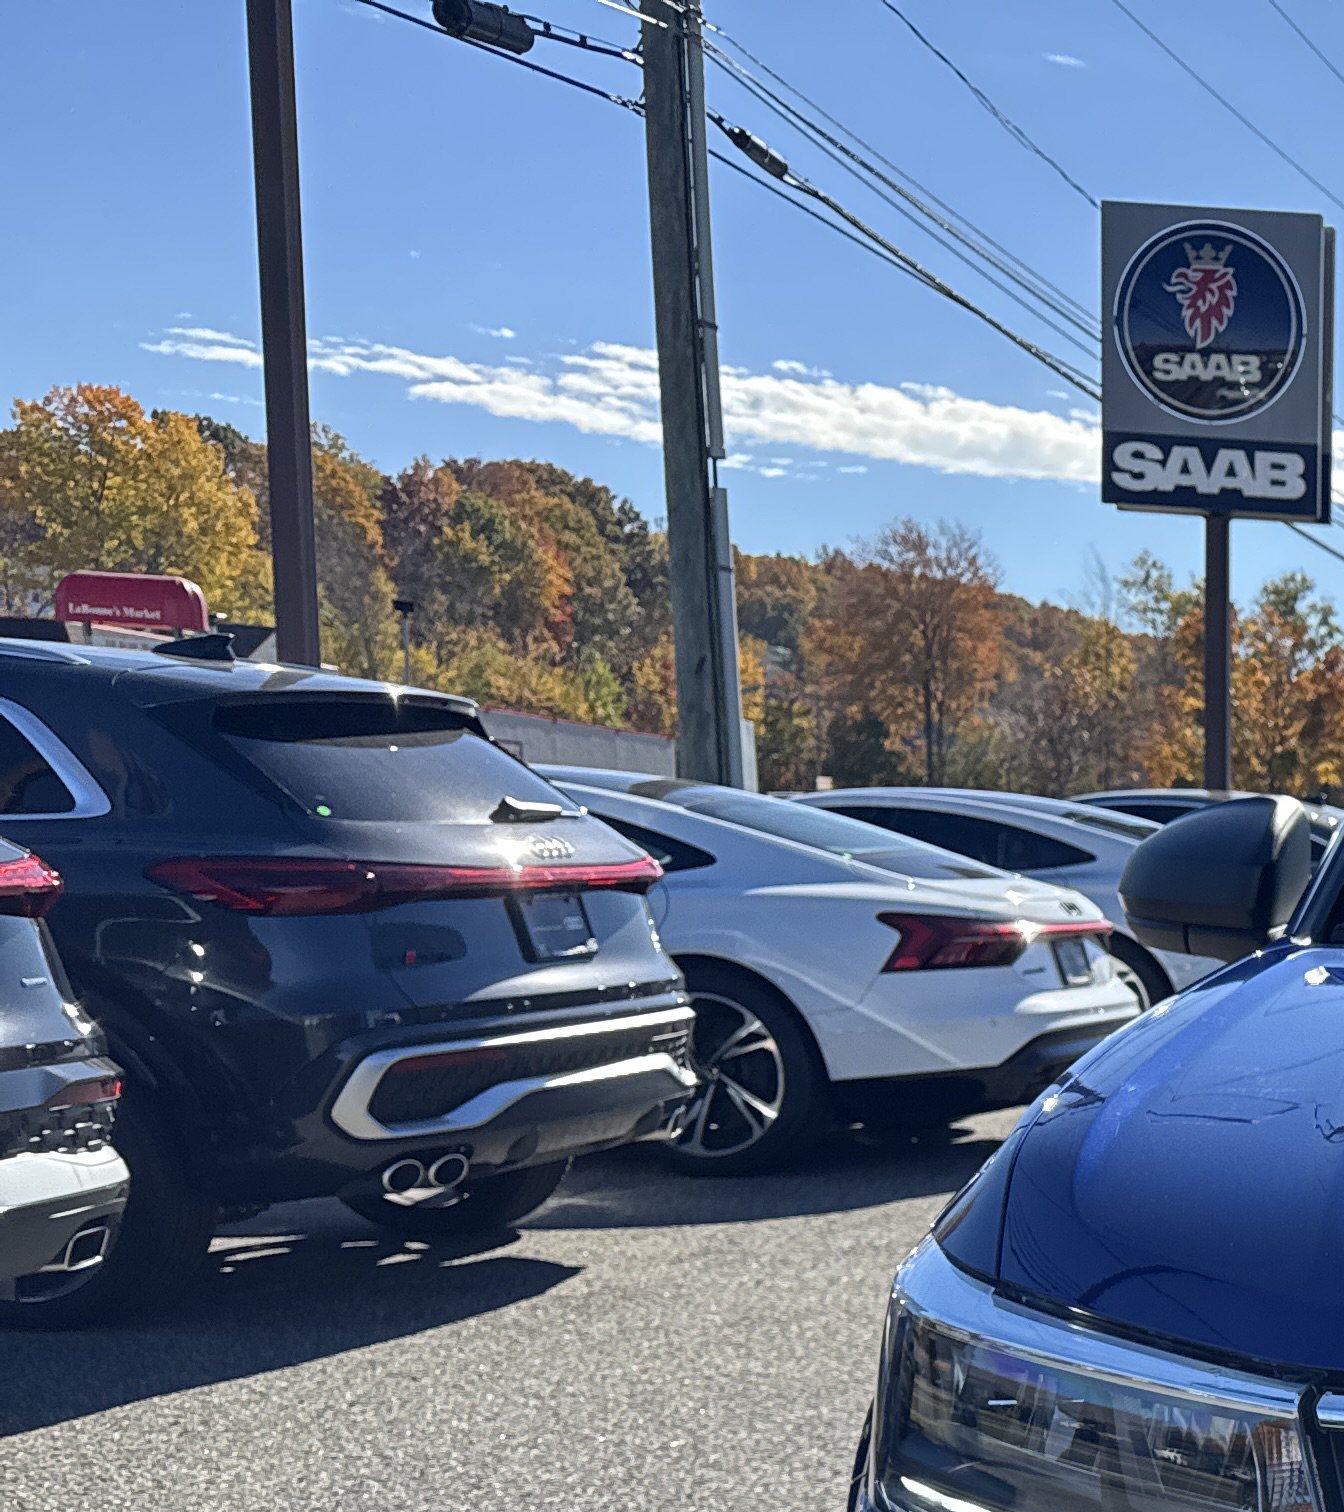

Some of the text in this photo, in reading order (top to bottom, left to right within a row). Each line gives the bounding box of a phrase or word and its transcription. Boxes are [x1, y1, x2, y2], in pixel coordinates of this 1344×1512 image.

[1152, 352, 1263, 383] SAAB
[1111, 441, 1307, 500] SAAB
[122, 606, 161, 620] Market
